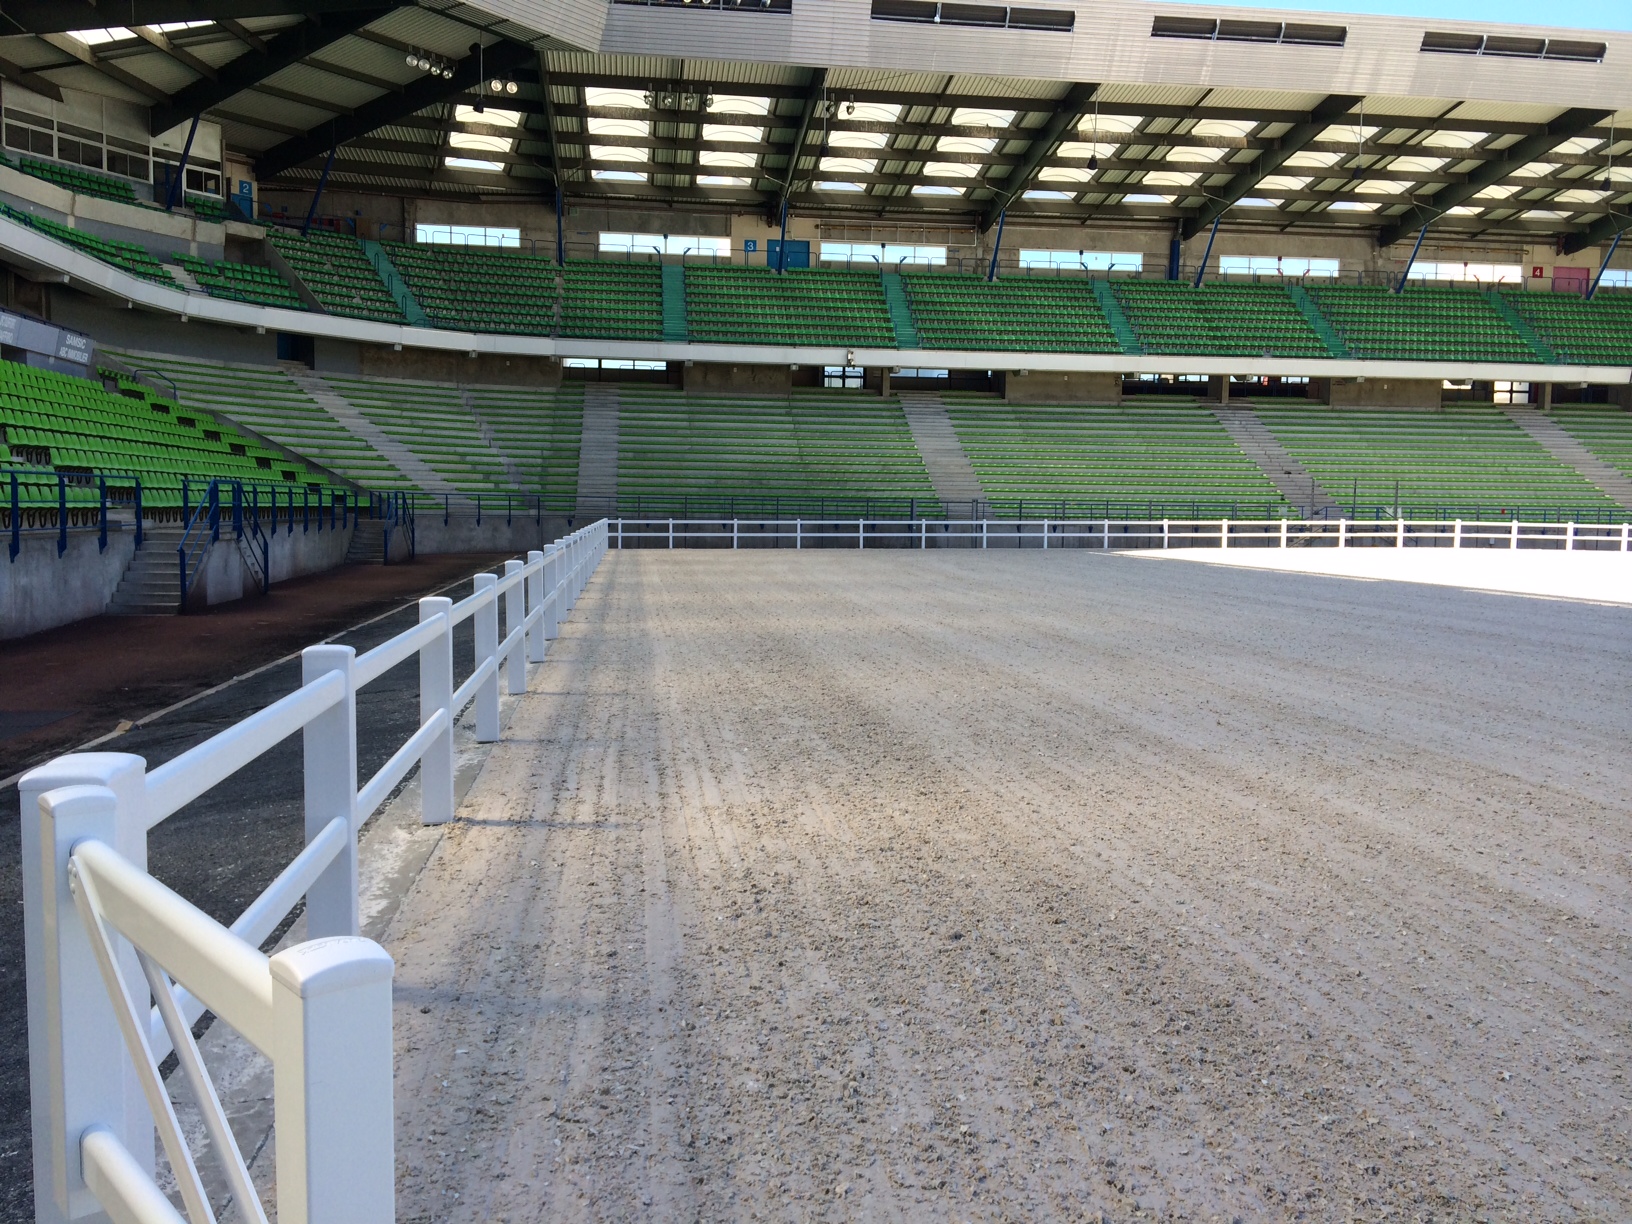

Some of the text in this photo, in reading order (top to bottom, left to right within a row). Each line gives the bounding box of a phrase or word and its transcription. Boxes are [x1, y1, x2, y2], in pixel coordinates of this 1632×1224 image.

[242, 183, 249, 193] 2
[747, 241, 754, 251] 3
[65, 334, 87, 349] SAMSIC
